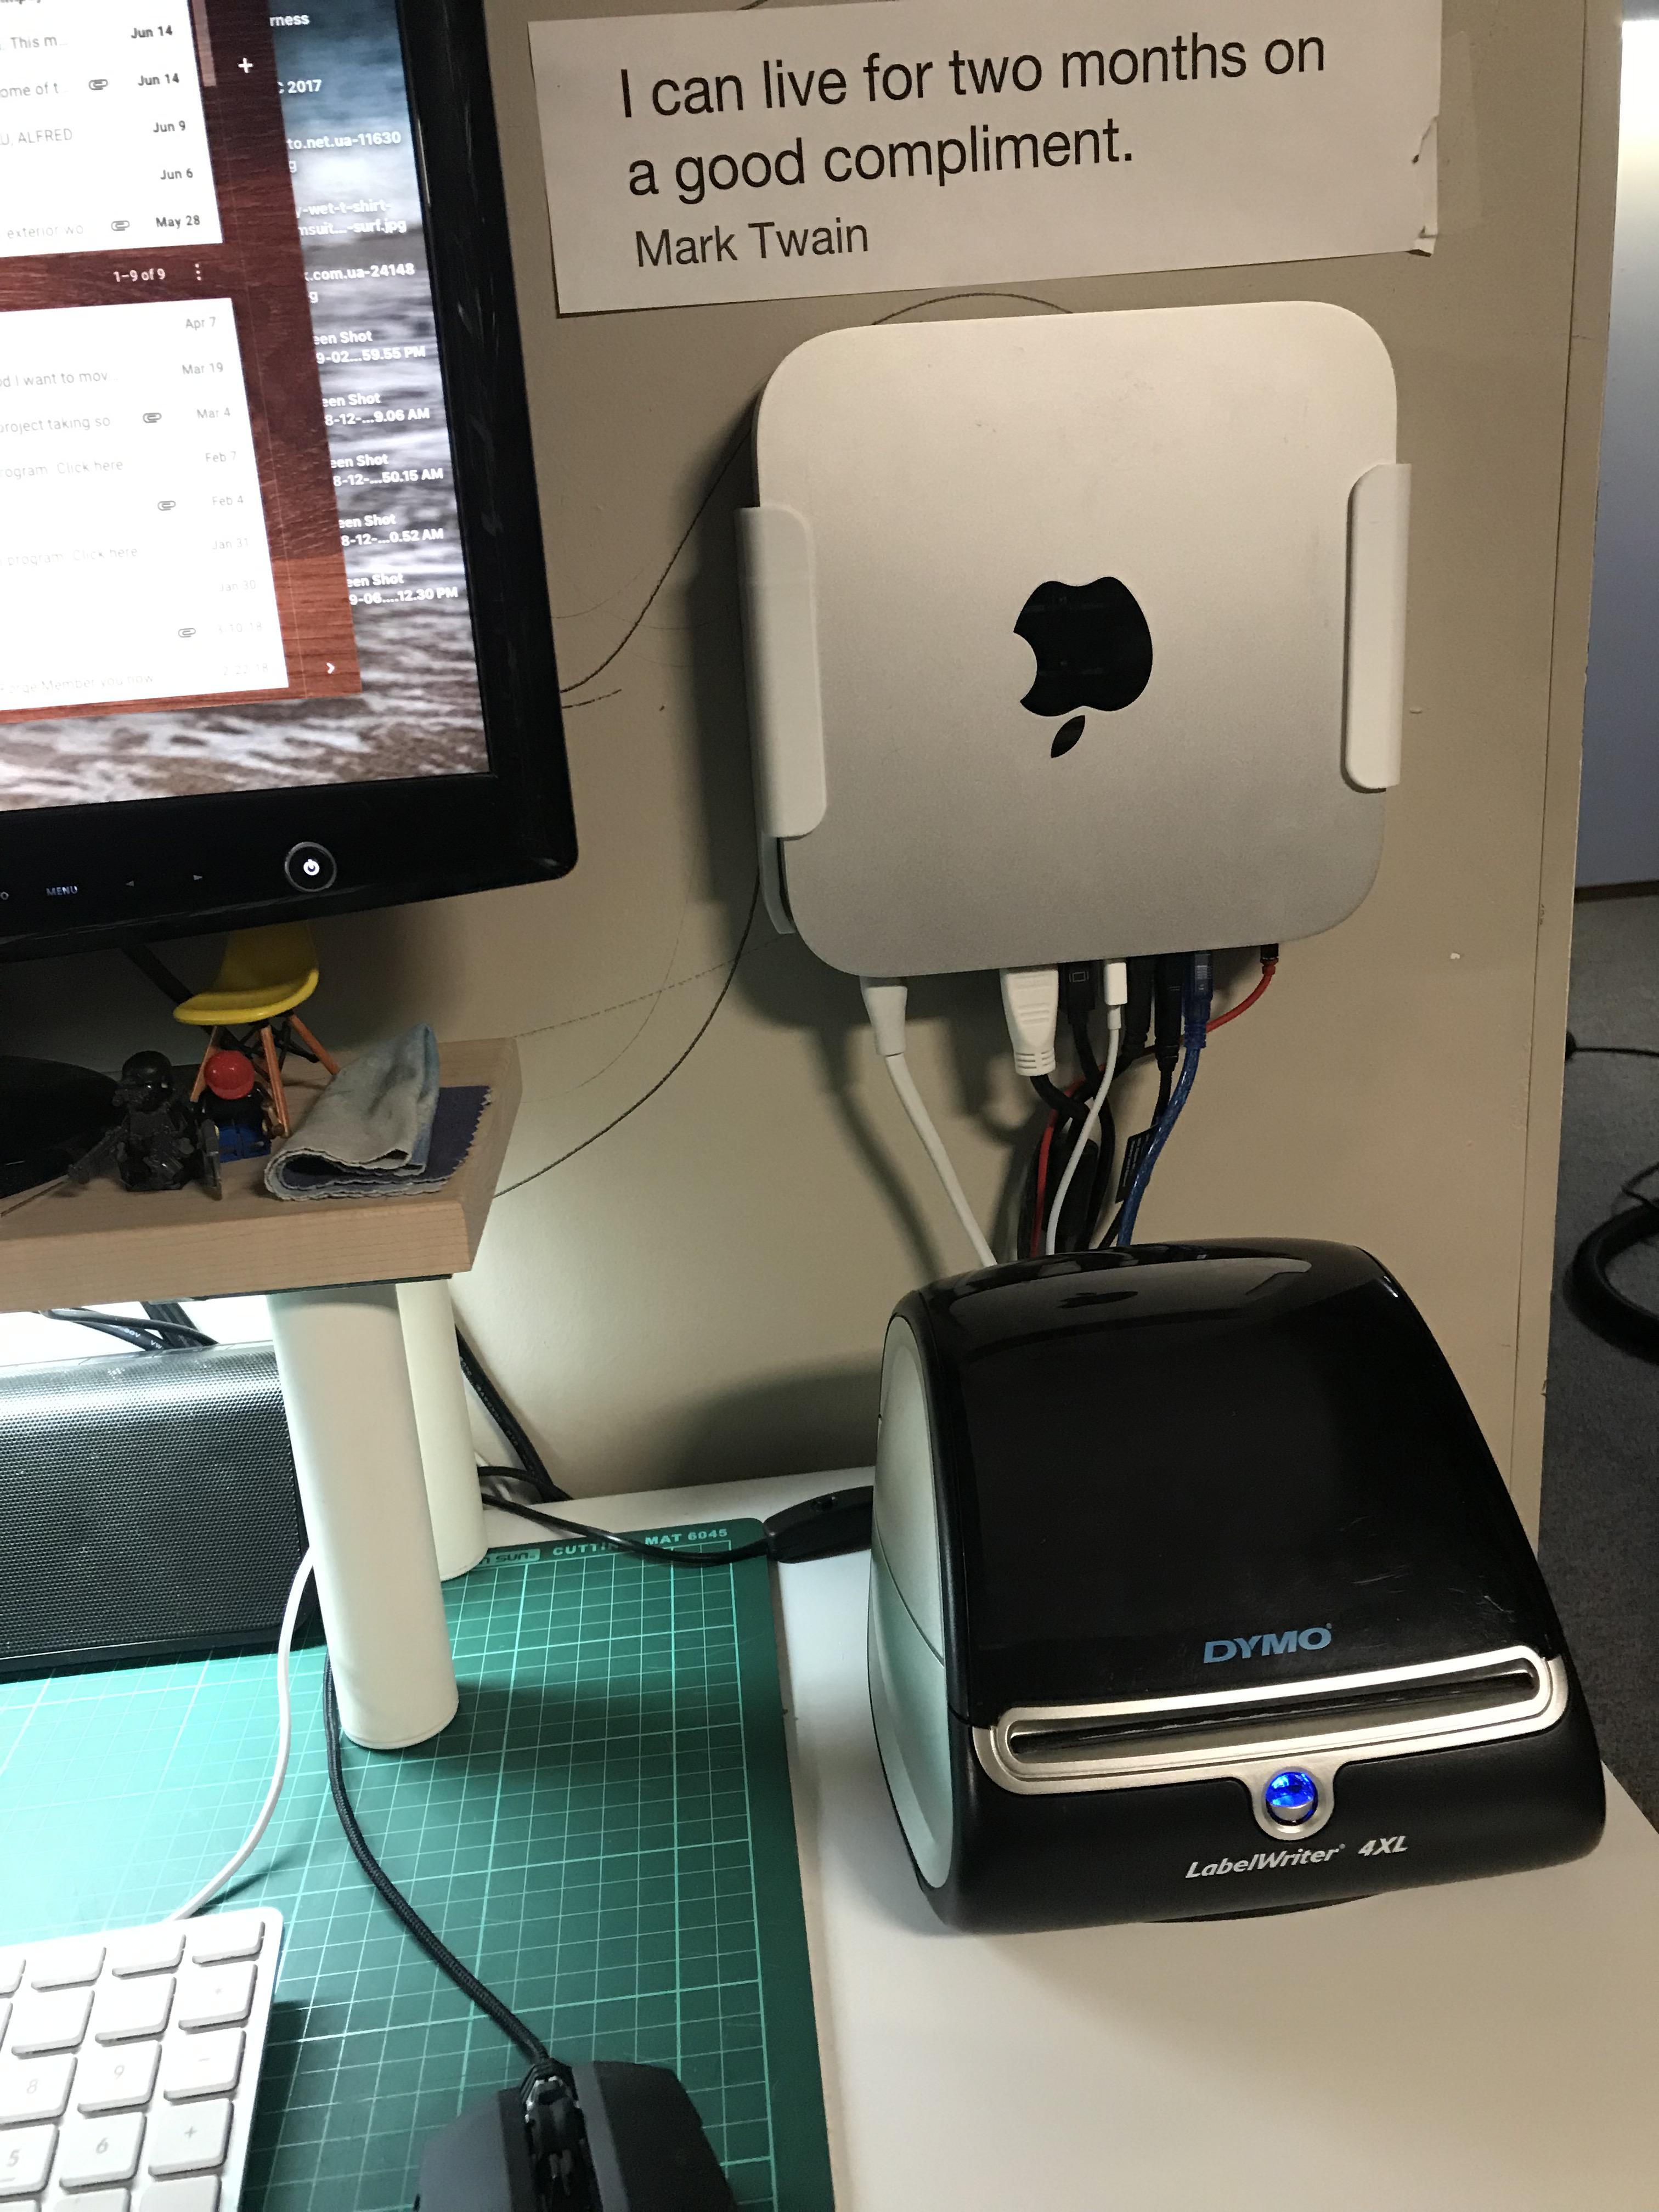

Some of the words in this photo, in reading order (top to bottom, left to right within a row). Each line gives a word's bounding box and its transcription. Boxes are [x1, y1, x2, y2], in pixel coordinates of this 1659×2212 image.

[131, 27, 154, 39] Jun
[157, 25, 173, 36] 14
[10, 36, 40, 49] This
[138, 75, 160, 86] Jun
[165, 73, 179, 84] 14
[621, 69, 632, 117] I
[652, 74, 744, 116] can
[763, 59, 847, 109] live
[864, 52, 933, 102] for
[949, 49, 1042, 95] two
[1062, 32, 1246, 88] months
[1265, 35, 1324, 75] on
[35, 81, 48, 95] of
[287, 79, 323, 93] 2017
[153, 122, 175, 133] Jun
[179, 120, 186, 131] 9
[18, 128, 72, 143] ALFRED
[629, 159, 659, 196] a
[675, 137, 805, 204] good
[825, 119, 1132, 187] compliment.
[160, 170, 182, 180] Jun
[186, 168, 194, 178] 6
[156, 217, 181, 229] May
[186, 215, 200, 226] 28
[636, 225, 738, 267] Mark
[748, 217, 868, 259] Twain
[141, 267, 154, 281] of
[157, 268, 166, 280] 9
[185, 318, 205, 331] Apr
[209, 317, 216, 328] 7
[340, 331, 373, 343] Shot
[404, 346, 426, 358] PM
[182, 364, 205, 375] Mar
[209, 362, 224, 373] 19
[24, 374, 57, 386] want
[61, 373, 75, 384] to
[348, 393, 381, 405] Shot
[196, 408, 219, 420] Mar
[223, 407, 231, 417] 4
[408, 408, 430, 421] AM
[48, 417, 91, 431] taking
[95, 417, 110, 427] so
[205, 453, 227, 463] Feb
[230, 451, 237, 461] 7
[356, 454, 389, 466] Shot
[57, 461, 90, 475] Click
[94, 460, 123, 471] here
[421, 468, 443, 481] AM
[212, 496, 233, 506] Feb
[236, 495, 244, 505] 4
[364, 514, 396, 527] Shot
[422, 528, 443, 541] AM
[212, 539, 233, 551] Jan
[236, 538, 249, 548] 31
[110, 548, 138, 559] here
[372, 572, 404, 585] Shot
[436, 586, 458, 599] PM
[46, 885, 78, 896] MENU
[645, 1533, 682, 1545] MAT
[688, 1528, 727, 1541] 6045
[1203, 1627, 1332, 1664] DYMO
[1186, 1847, 1340, 1879] LabelWriter
[1358, 1835, 1409, 1857] 4XL
[114, 2065, 125, 2079] 9
[95, 2137, 108, 2154] 6
[7, 2149, 20, 2166] 5
